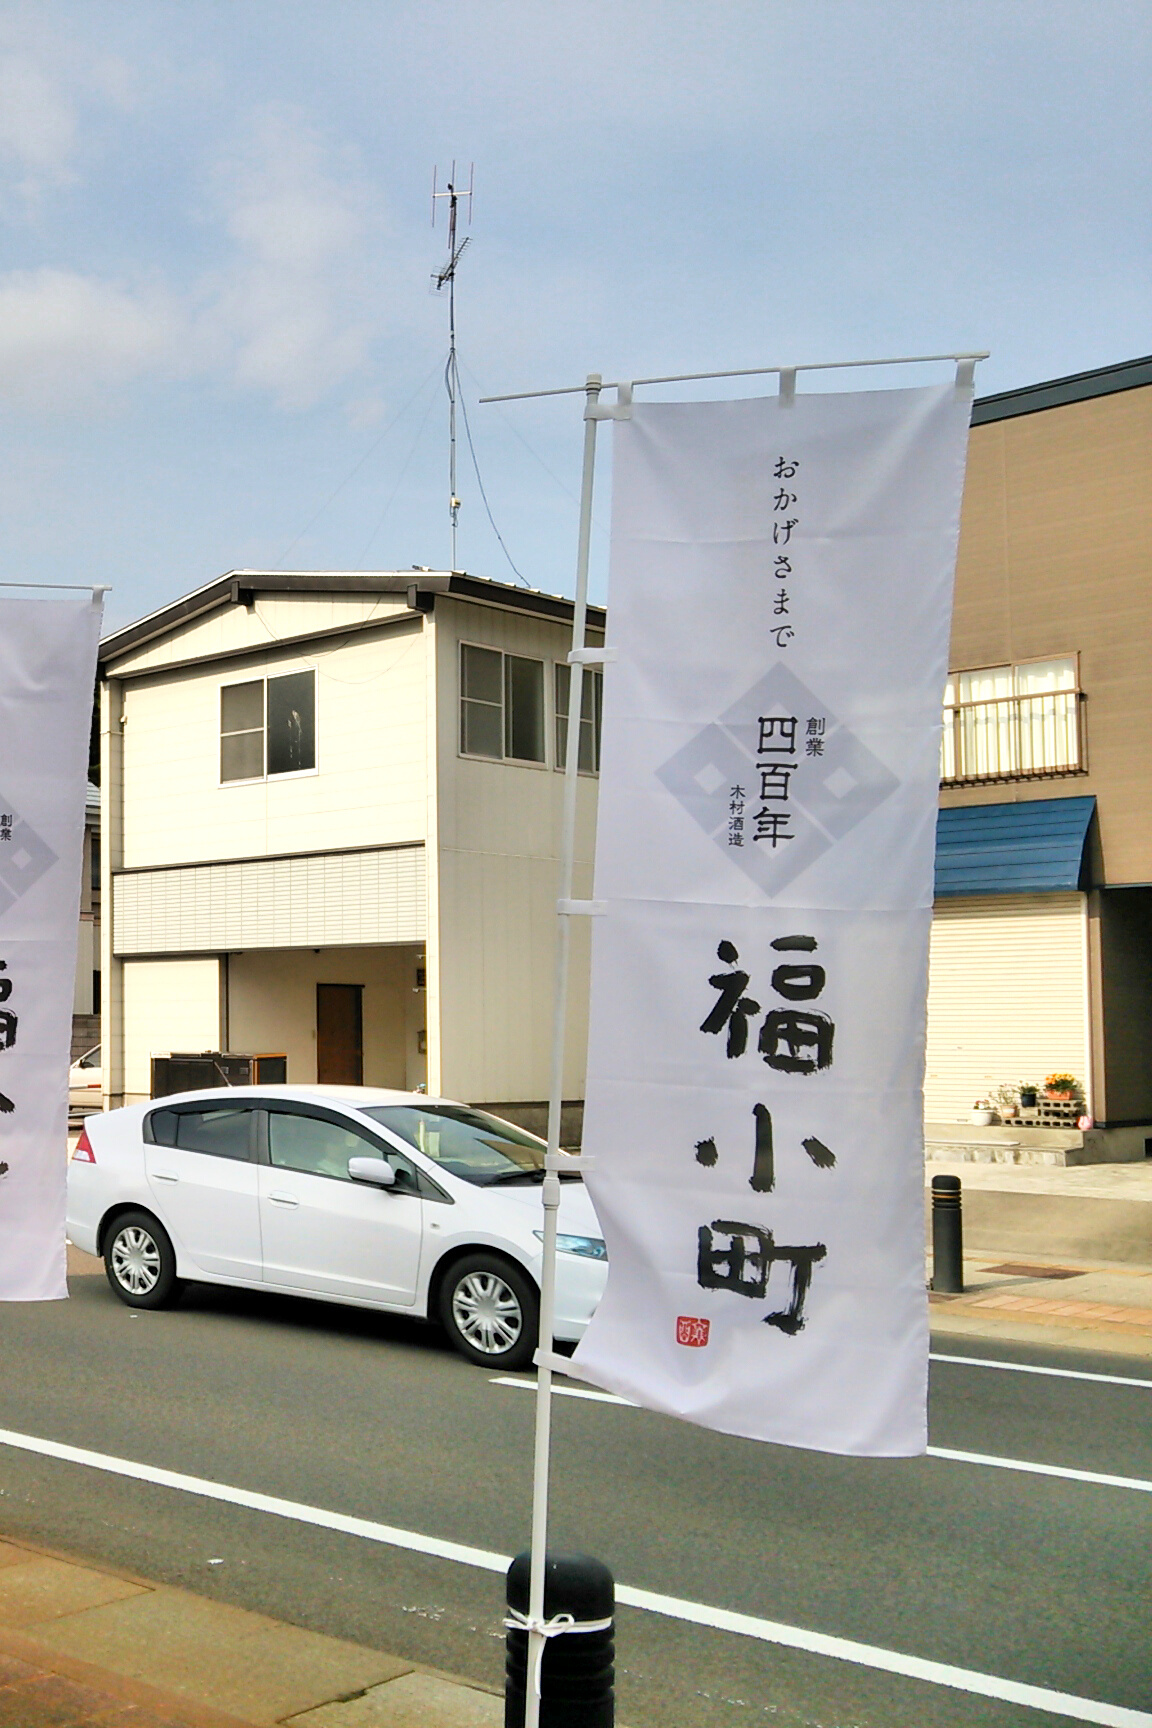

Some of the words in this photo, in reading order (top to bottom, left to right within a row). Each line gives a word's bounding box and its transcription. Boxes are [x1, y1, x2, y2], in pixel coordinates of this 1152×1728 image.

[769, 456, 800, 648] おかげさまで
[752, 716, 798, 848] 四百年
[805, 716, 826, 757] 創業
[0, 813, 13, 841] 創業
[728, 784, 746, 847] 木村酒造
[694, 934, 837, 1336] 福小町
